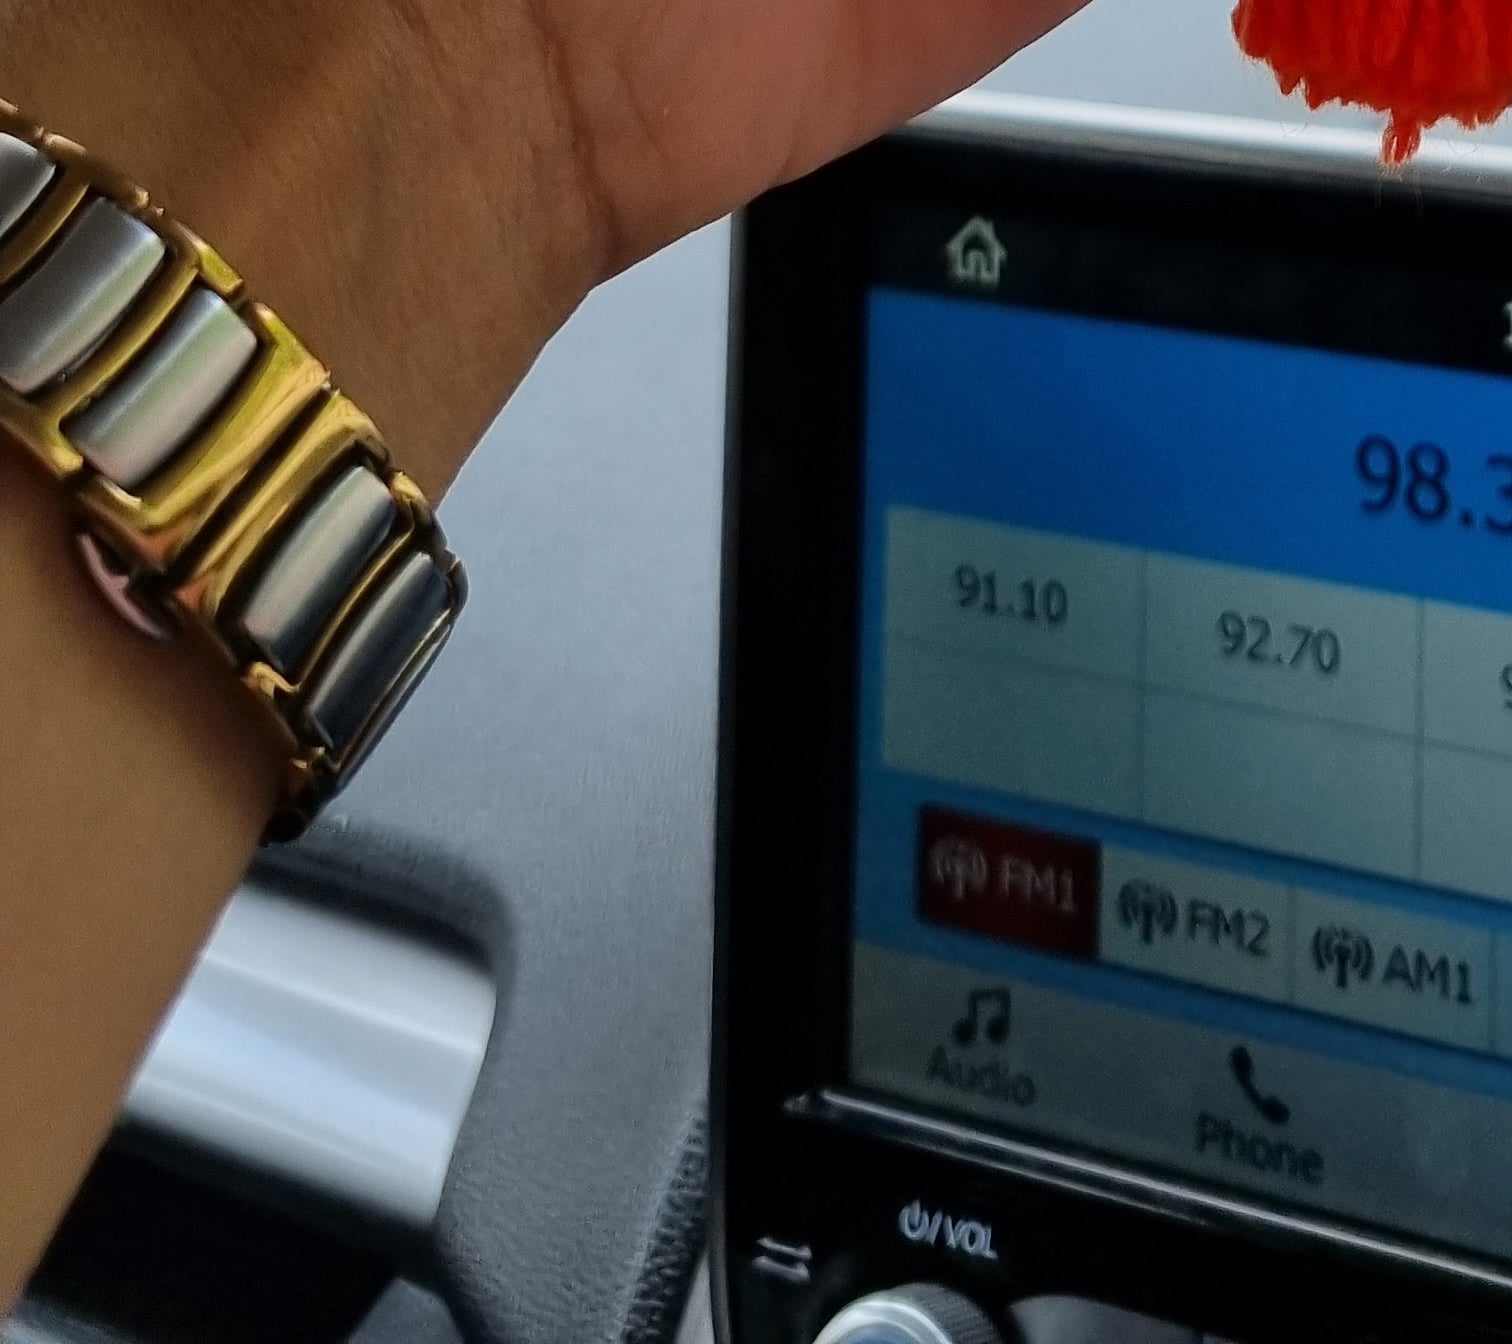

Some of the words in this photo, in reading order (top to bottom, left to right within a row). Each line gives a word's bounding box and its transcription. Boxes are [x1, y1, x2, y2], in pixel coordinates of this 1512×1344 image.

[953, 563, 1069, 626] 91.10
[1215, 611, 1343, 676] 92.70
[1002, 856, 1077, 914] FM1
[1188, 898, 1271, 958] FM2
[1382, 942, 1474, 1007] AM1
[925, 1045, 1036, 1107] Audio
[1194, 1112, 1322, 1183] Phone
